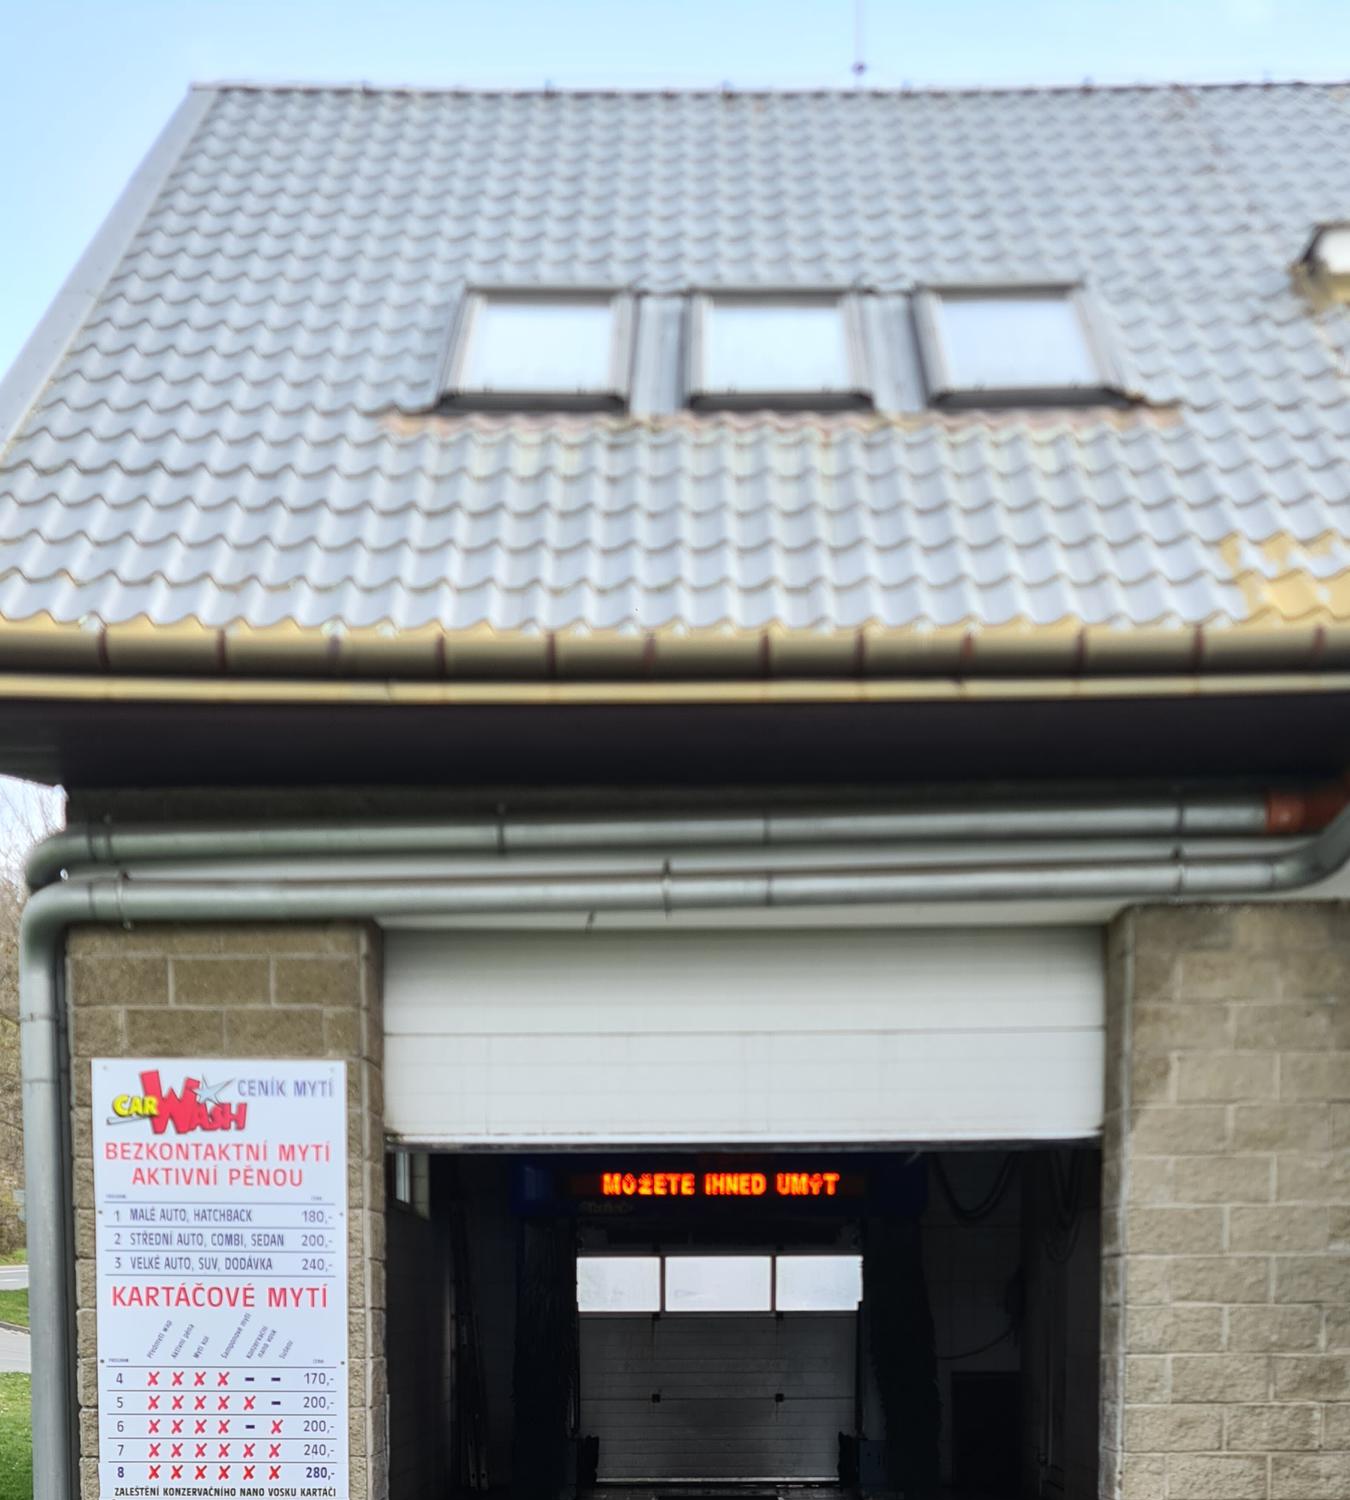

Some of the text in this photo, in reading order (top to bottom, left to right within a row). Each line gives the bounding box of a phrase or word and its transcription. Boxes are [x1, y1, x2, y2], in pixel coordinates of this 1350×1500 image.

[237, 1077, 334, 1097] CENÍK MYTÍ
[112, 1094, 159, 1117] CAR
[105, 1140, 330, 1162] BEZKONTAKTNÍ MYTÍ
[132, 1165, 303, 1186] AKTIVNÍ PĚNOU
[705, 1173, 767, 1195] IHNED
[115, 1208, 333, 1223] 1 MALÉ AUTO, HATCHBACK 180,-
[115, 1232, 333, 1248] 2 STŘEDNÍ AUTO, COMBI, SEDAN 200,-
[115, 1255, 333, 1271] 3 VELKÉ AUTO, SUV, DODÁVKA 240,-
[112, 1283, 327, 1308] KARTÁČOVÉ MYTÍ
[116, 1373, 334, 1386] 4 170,-
[116, 1397, 334, 1409] 5 200,-
[117, 1420, 335, 1433] 6 200,-
[117, 1444, 335, 1457] 7 240,-
[117, 1467, 335, 1480] 8 280,-
[115, 1486, 160, 1496] ZALEŠTĚNÍ
[163, 1486, 236, 1497] KONZERVAČNÍHO
[240, 1488, 265, 1496] NANO
[268, 1488, 297, 1497] VOSKU
